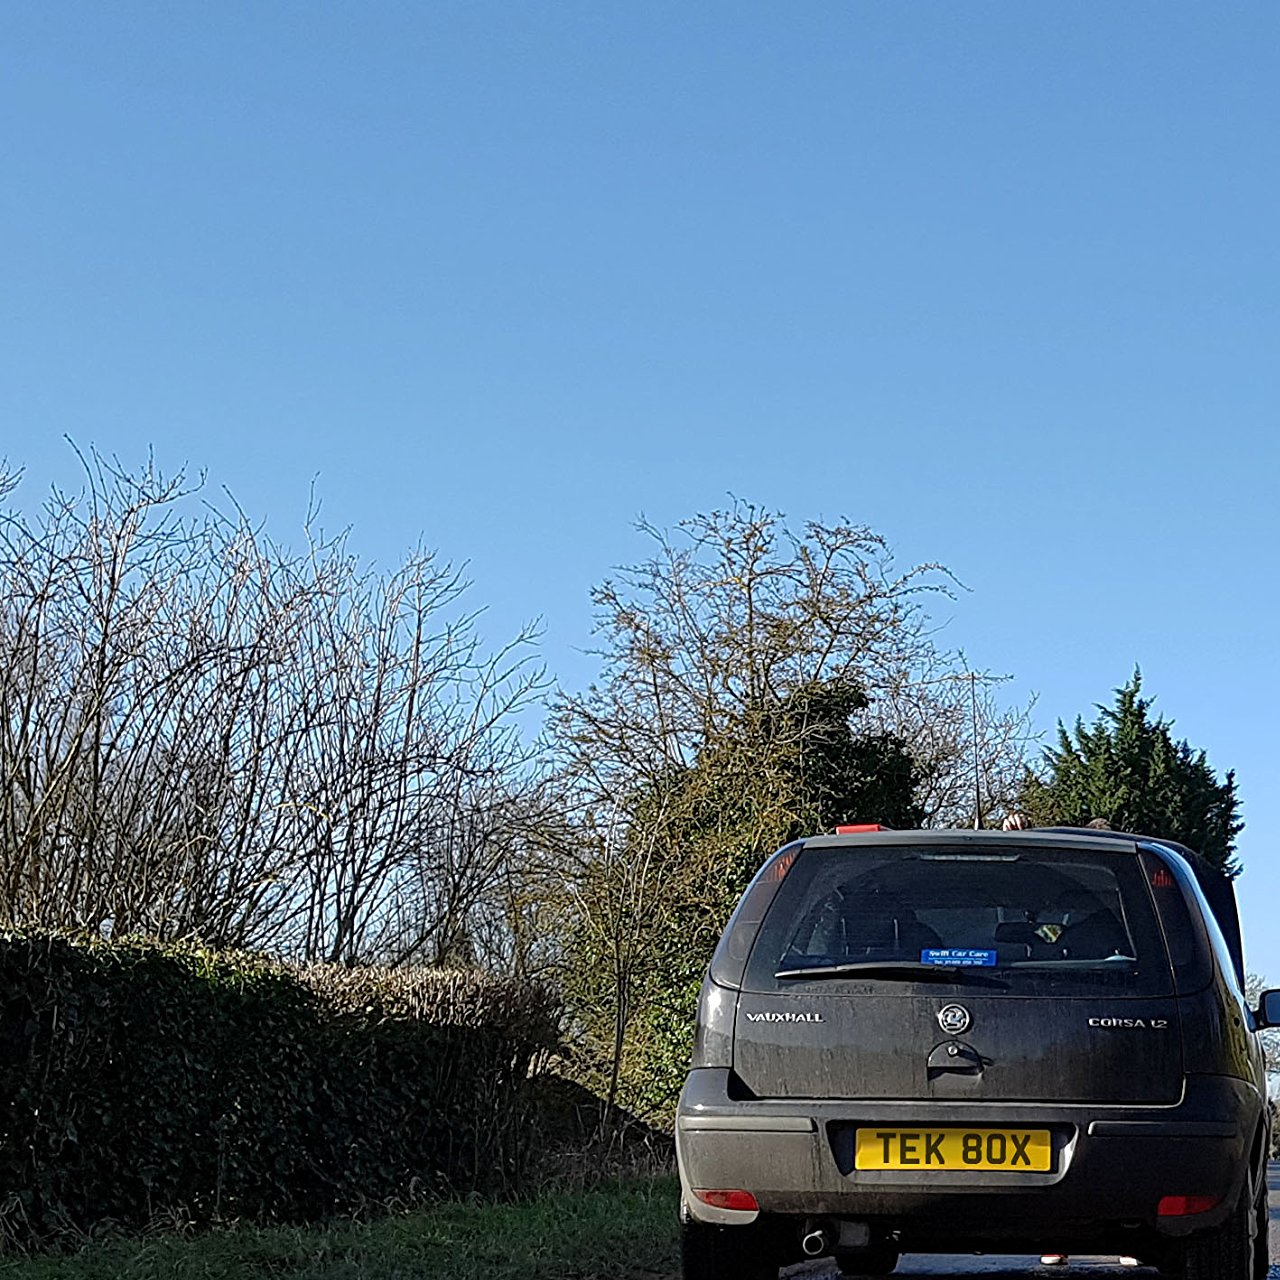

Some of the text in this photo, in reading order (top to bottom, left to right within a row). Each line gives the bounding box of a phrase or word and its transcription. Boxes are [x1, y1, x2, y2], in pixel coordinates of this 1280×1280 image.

[746, 1012, 824, 1023] VAUXHALL
[1088, 1017, 1146, 1028] CORSA
[876, 1132, 1031, 1166] TEK 80X
